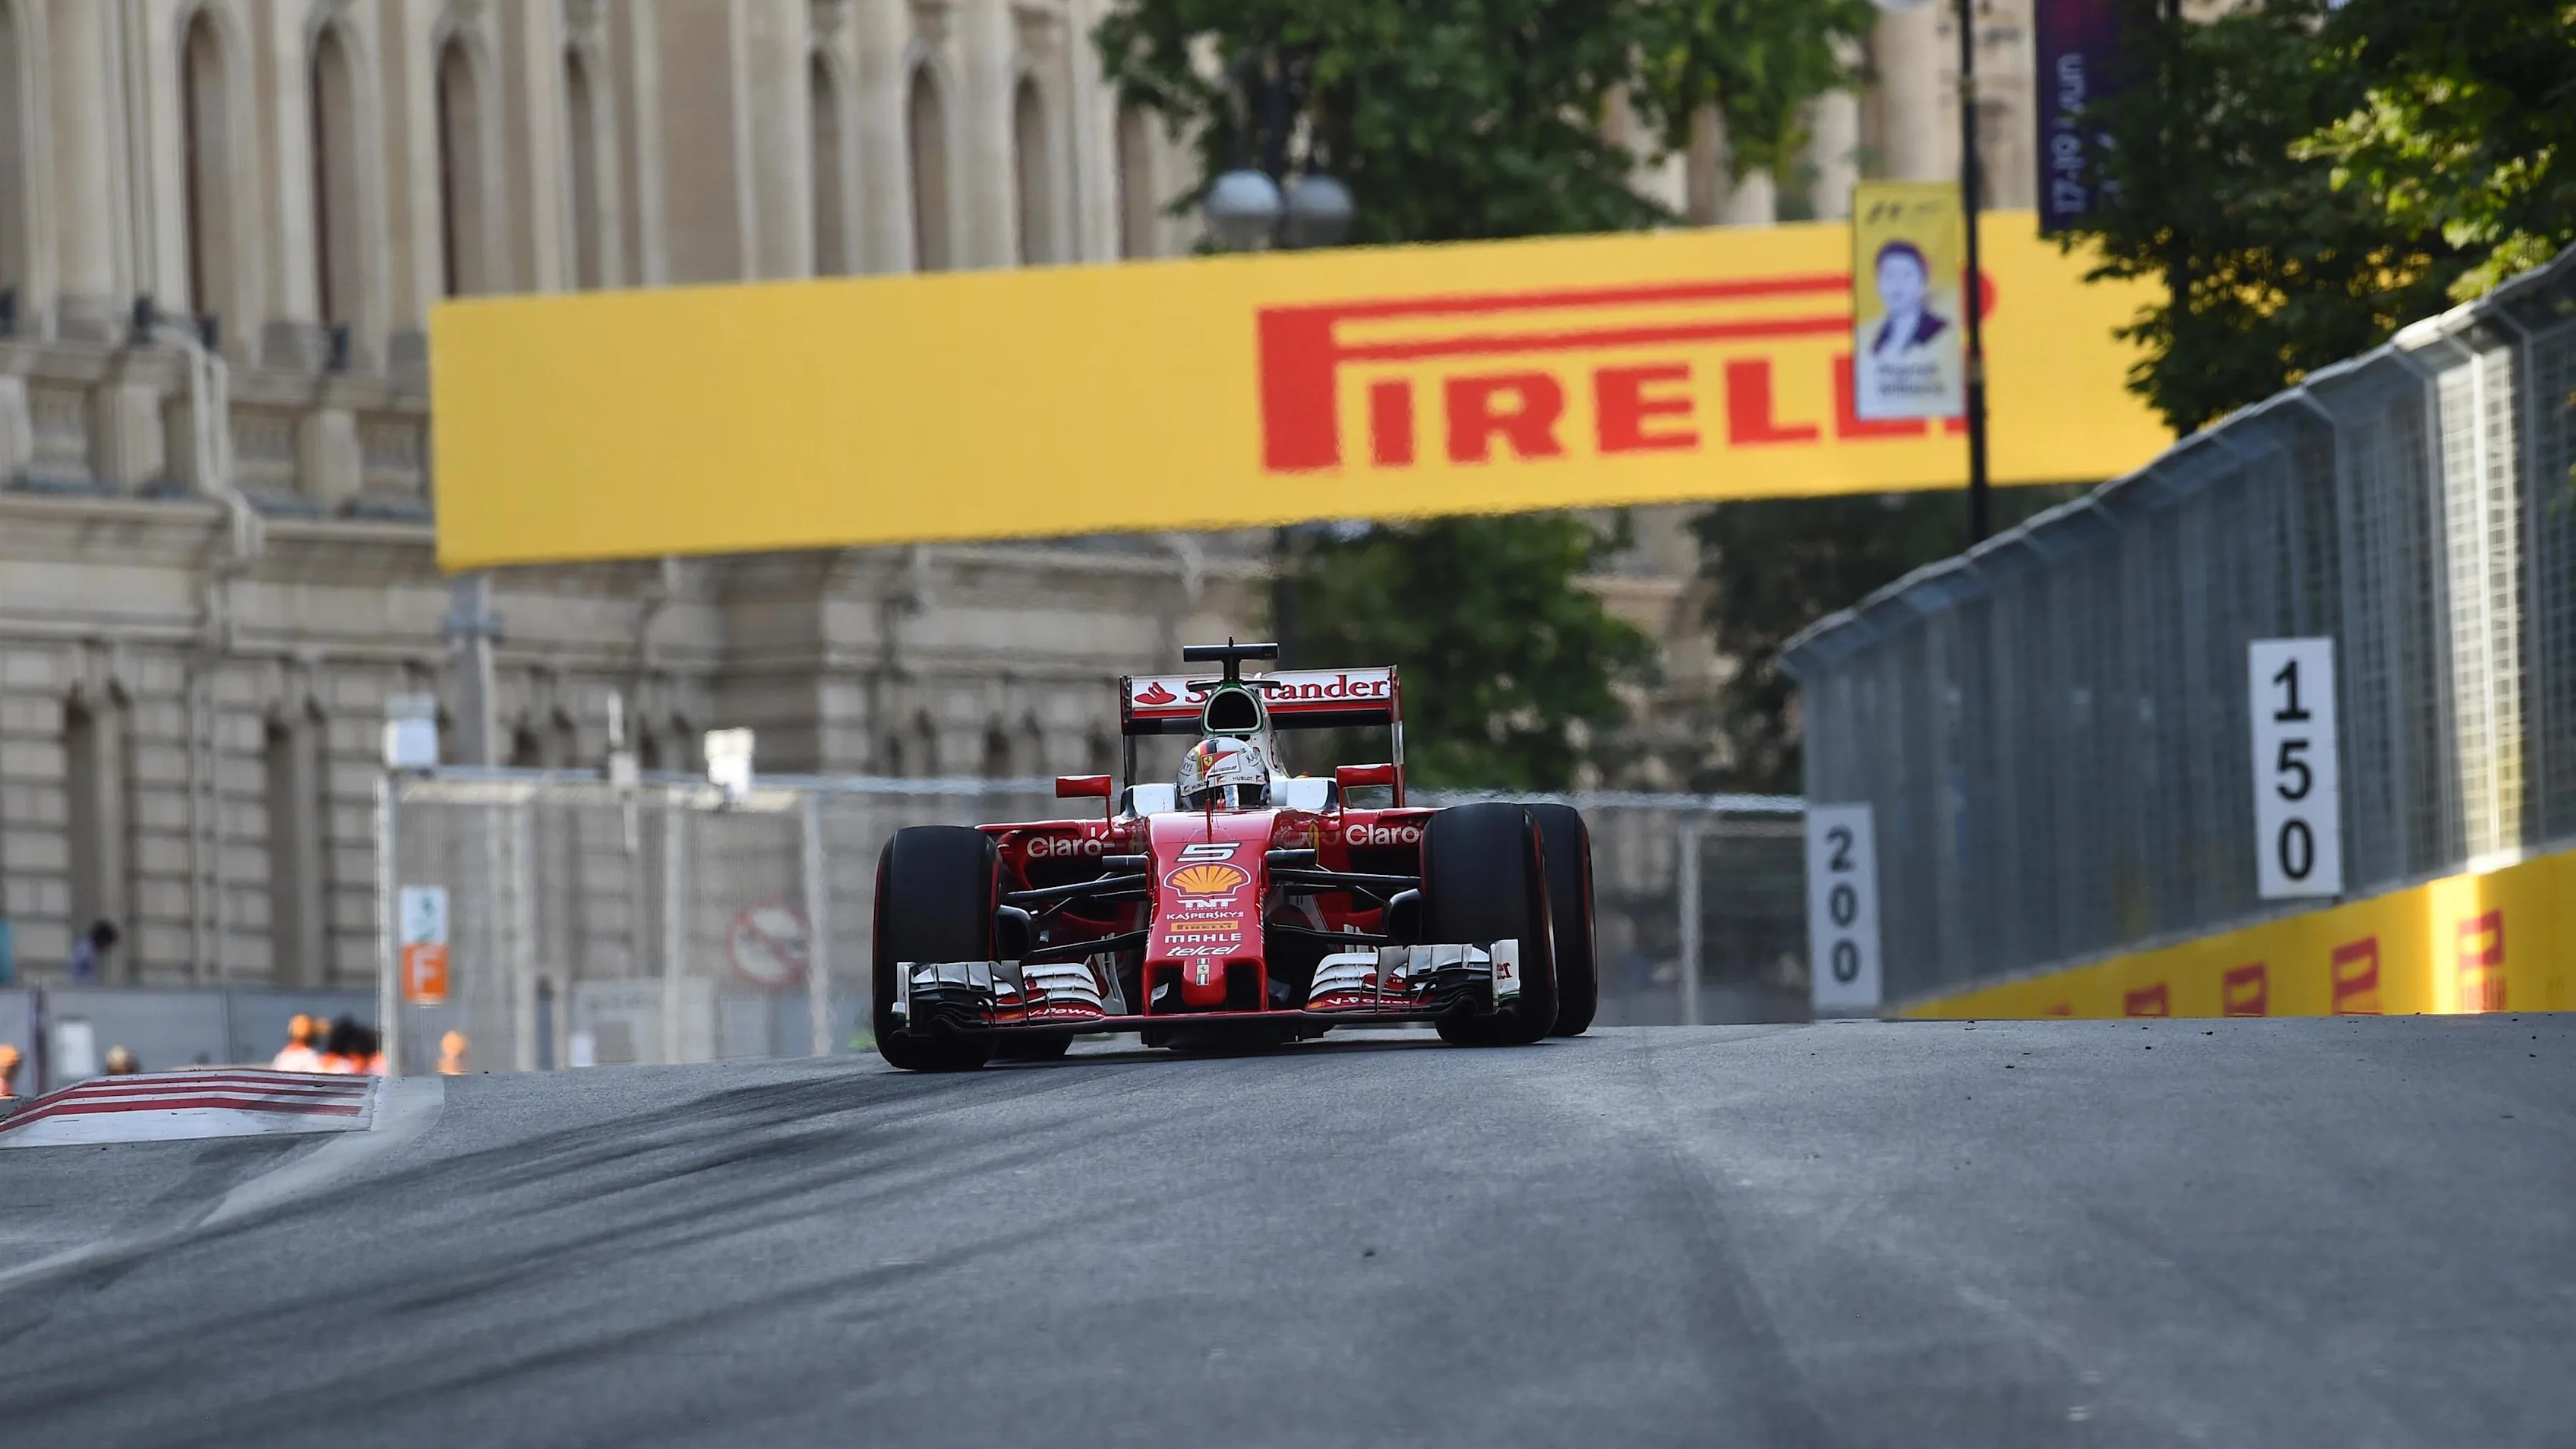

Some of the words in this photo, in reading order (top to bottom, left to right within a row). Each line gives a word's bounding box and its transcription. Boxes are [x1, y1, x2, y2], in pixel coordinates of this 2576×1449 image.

[1257, 275, 1997, 474] PIRELL
[1185, 674, 1388, 702] Stander
[2273, 658, 2314, 880] 150
[1345, 823, 1419, 845] Claro
[1027, 835, 1102, 858] Claro
[1175, 842, 1241, 862] 5
[1176, 898, 1238, 908] TNT
[1824, 825, 1861, 983] 200
[1164, 933, 1242, 943] MAHLE
[1166, 944, 1241, 957] telcel
